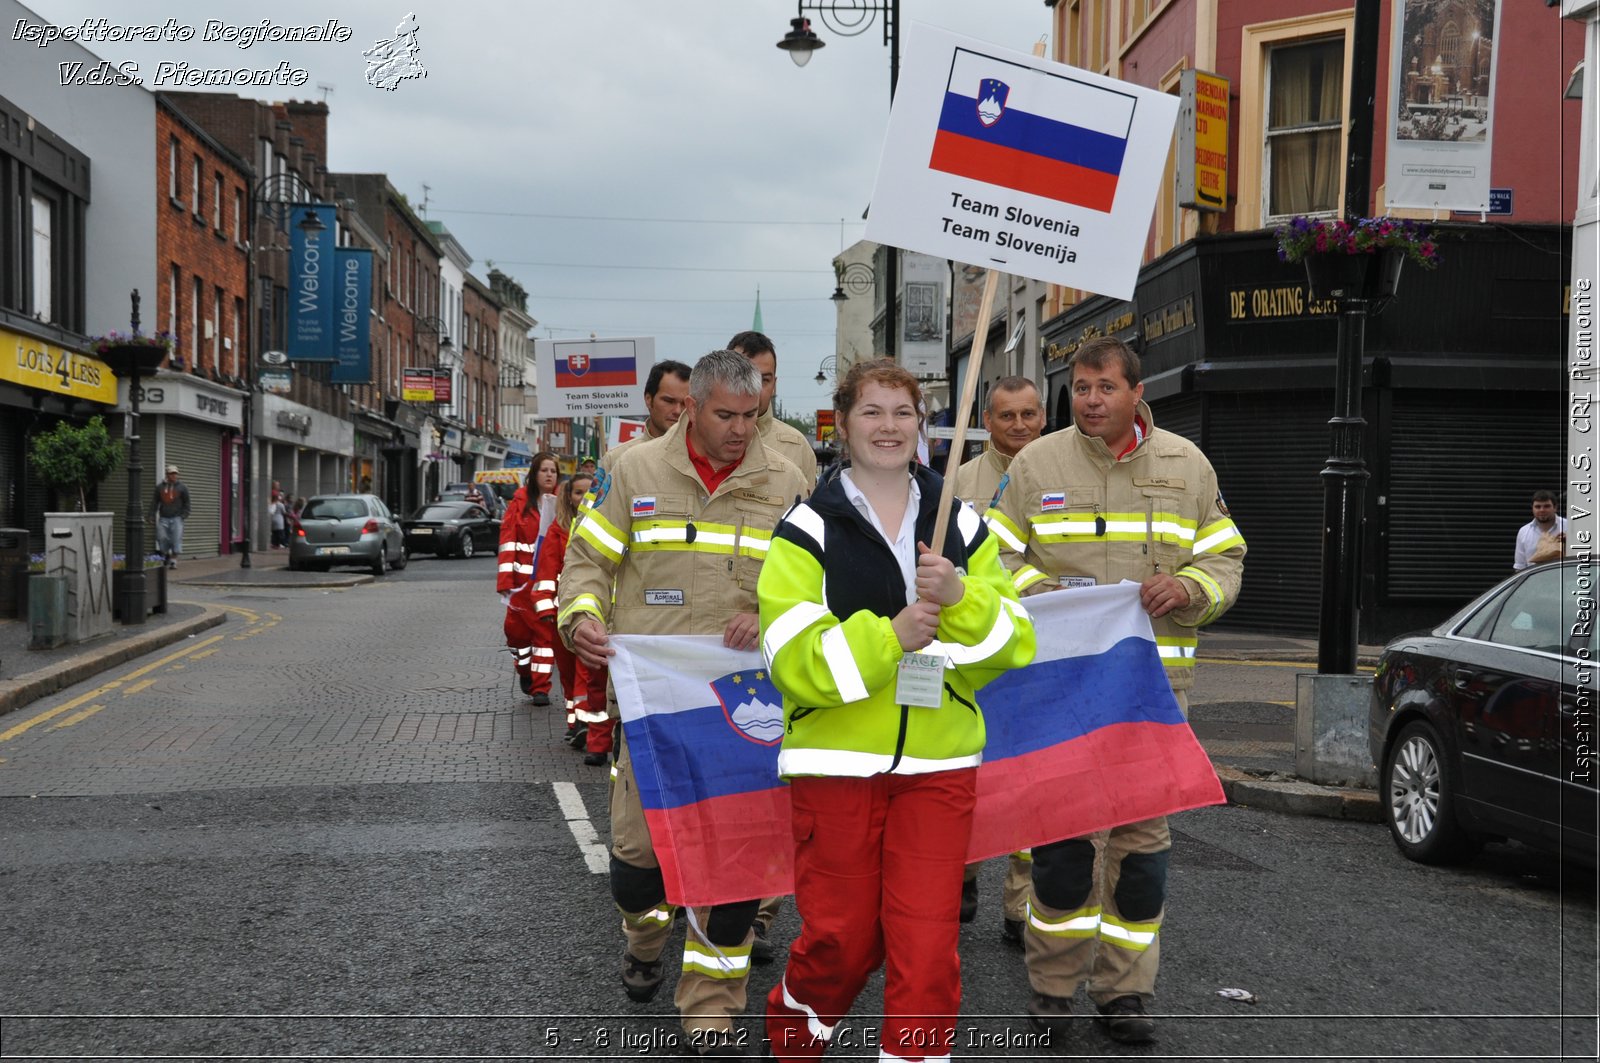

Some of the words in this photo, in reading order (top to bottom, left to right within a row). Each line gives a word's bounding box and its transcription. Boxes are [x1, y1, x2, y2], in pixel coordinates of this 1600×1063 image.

[1196, 79, 1227, 103] BRENDAN
[1196, 98, 1227, 121] MARMION
[1196, 117, 1208, 134] LTD
[1200, 169, 1219, 190] CENTRE
[950, 191, 999, 218] Team
[1004, 206, 1080, 238] Slovenia
[941, 217, 990, 243] Team
[995, 231, 1077, 263] Slovenija
[340, 258, 360, 342] Welcome
[17, 346, 54, 376] LOTS
[55, 351, 71, 390] 4
[71, 360, 101, 387] LESS
[585, 402, 629, 410] Slovensko
[592, 391, 628, 399] Slovakia
